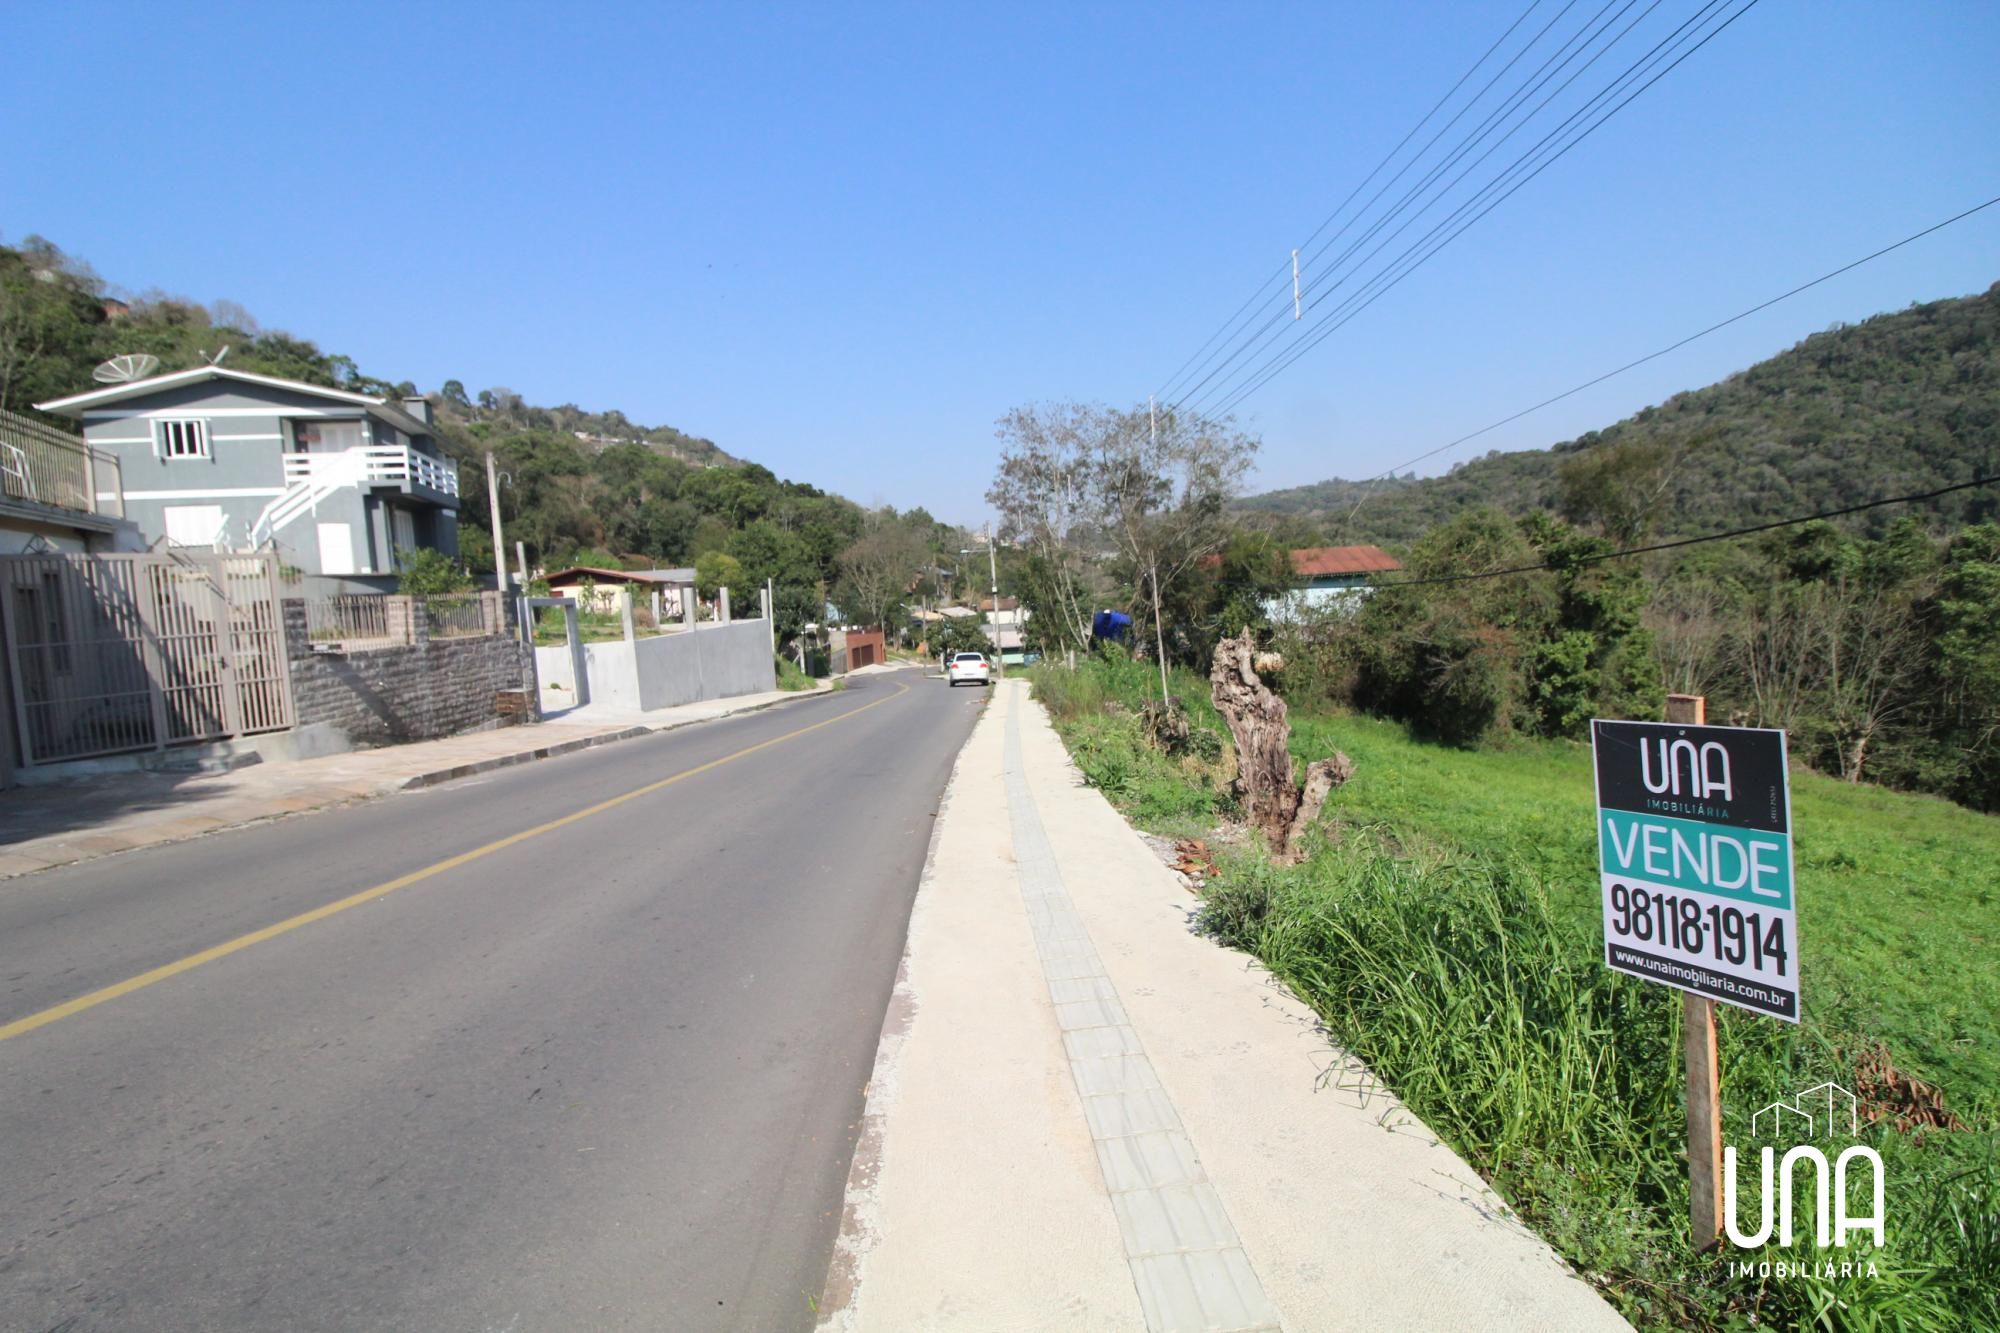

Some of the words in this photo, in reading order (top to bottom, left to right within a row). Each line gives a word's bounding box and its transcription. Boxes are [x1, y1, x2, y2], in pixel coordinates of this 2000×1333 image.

[1640, 736, 1732, 801] UNA
[1647, 798, 1729, 819] IMOBILIÁRIA
[1607, 818, 1782, 898] VENDE
[1611, 884, 1787, 976] 98118-1914
[1615, 950, 1787, 1007] www.unaimobiliaria.com.br
